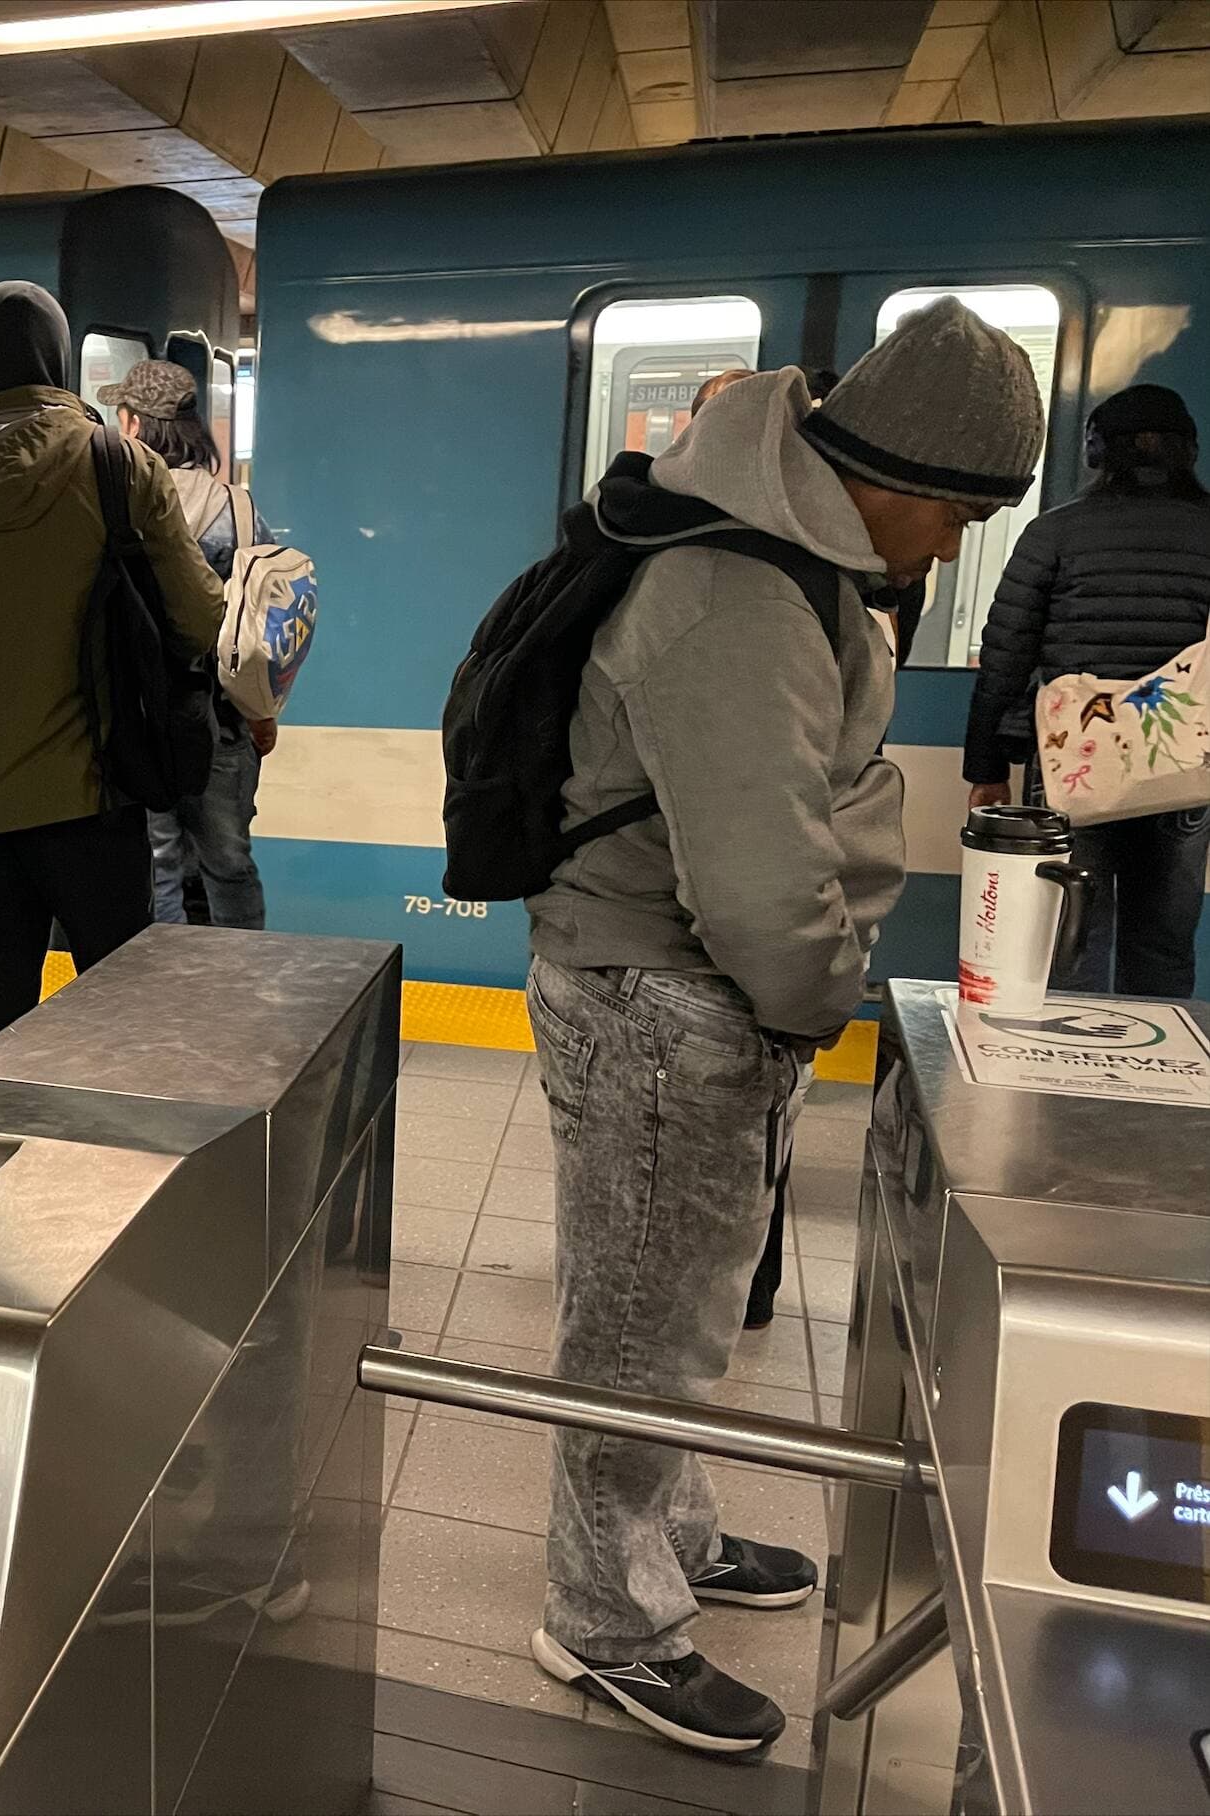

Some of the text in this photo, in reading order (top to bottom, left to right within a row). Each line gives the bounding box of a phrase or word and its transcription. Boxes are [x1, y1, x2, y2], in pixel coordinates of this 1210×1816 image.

[403, 895, 488, 919] 79-708
[976, 870, 1000, 934] Hortons
[977, 1043, 1205, 1070] CONSERVEZ
[980, 1051, 1209, 1077] VOTRE TITRE VALIDE
